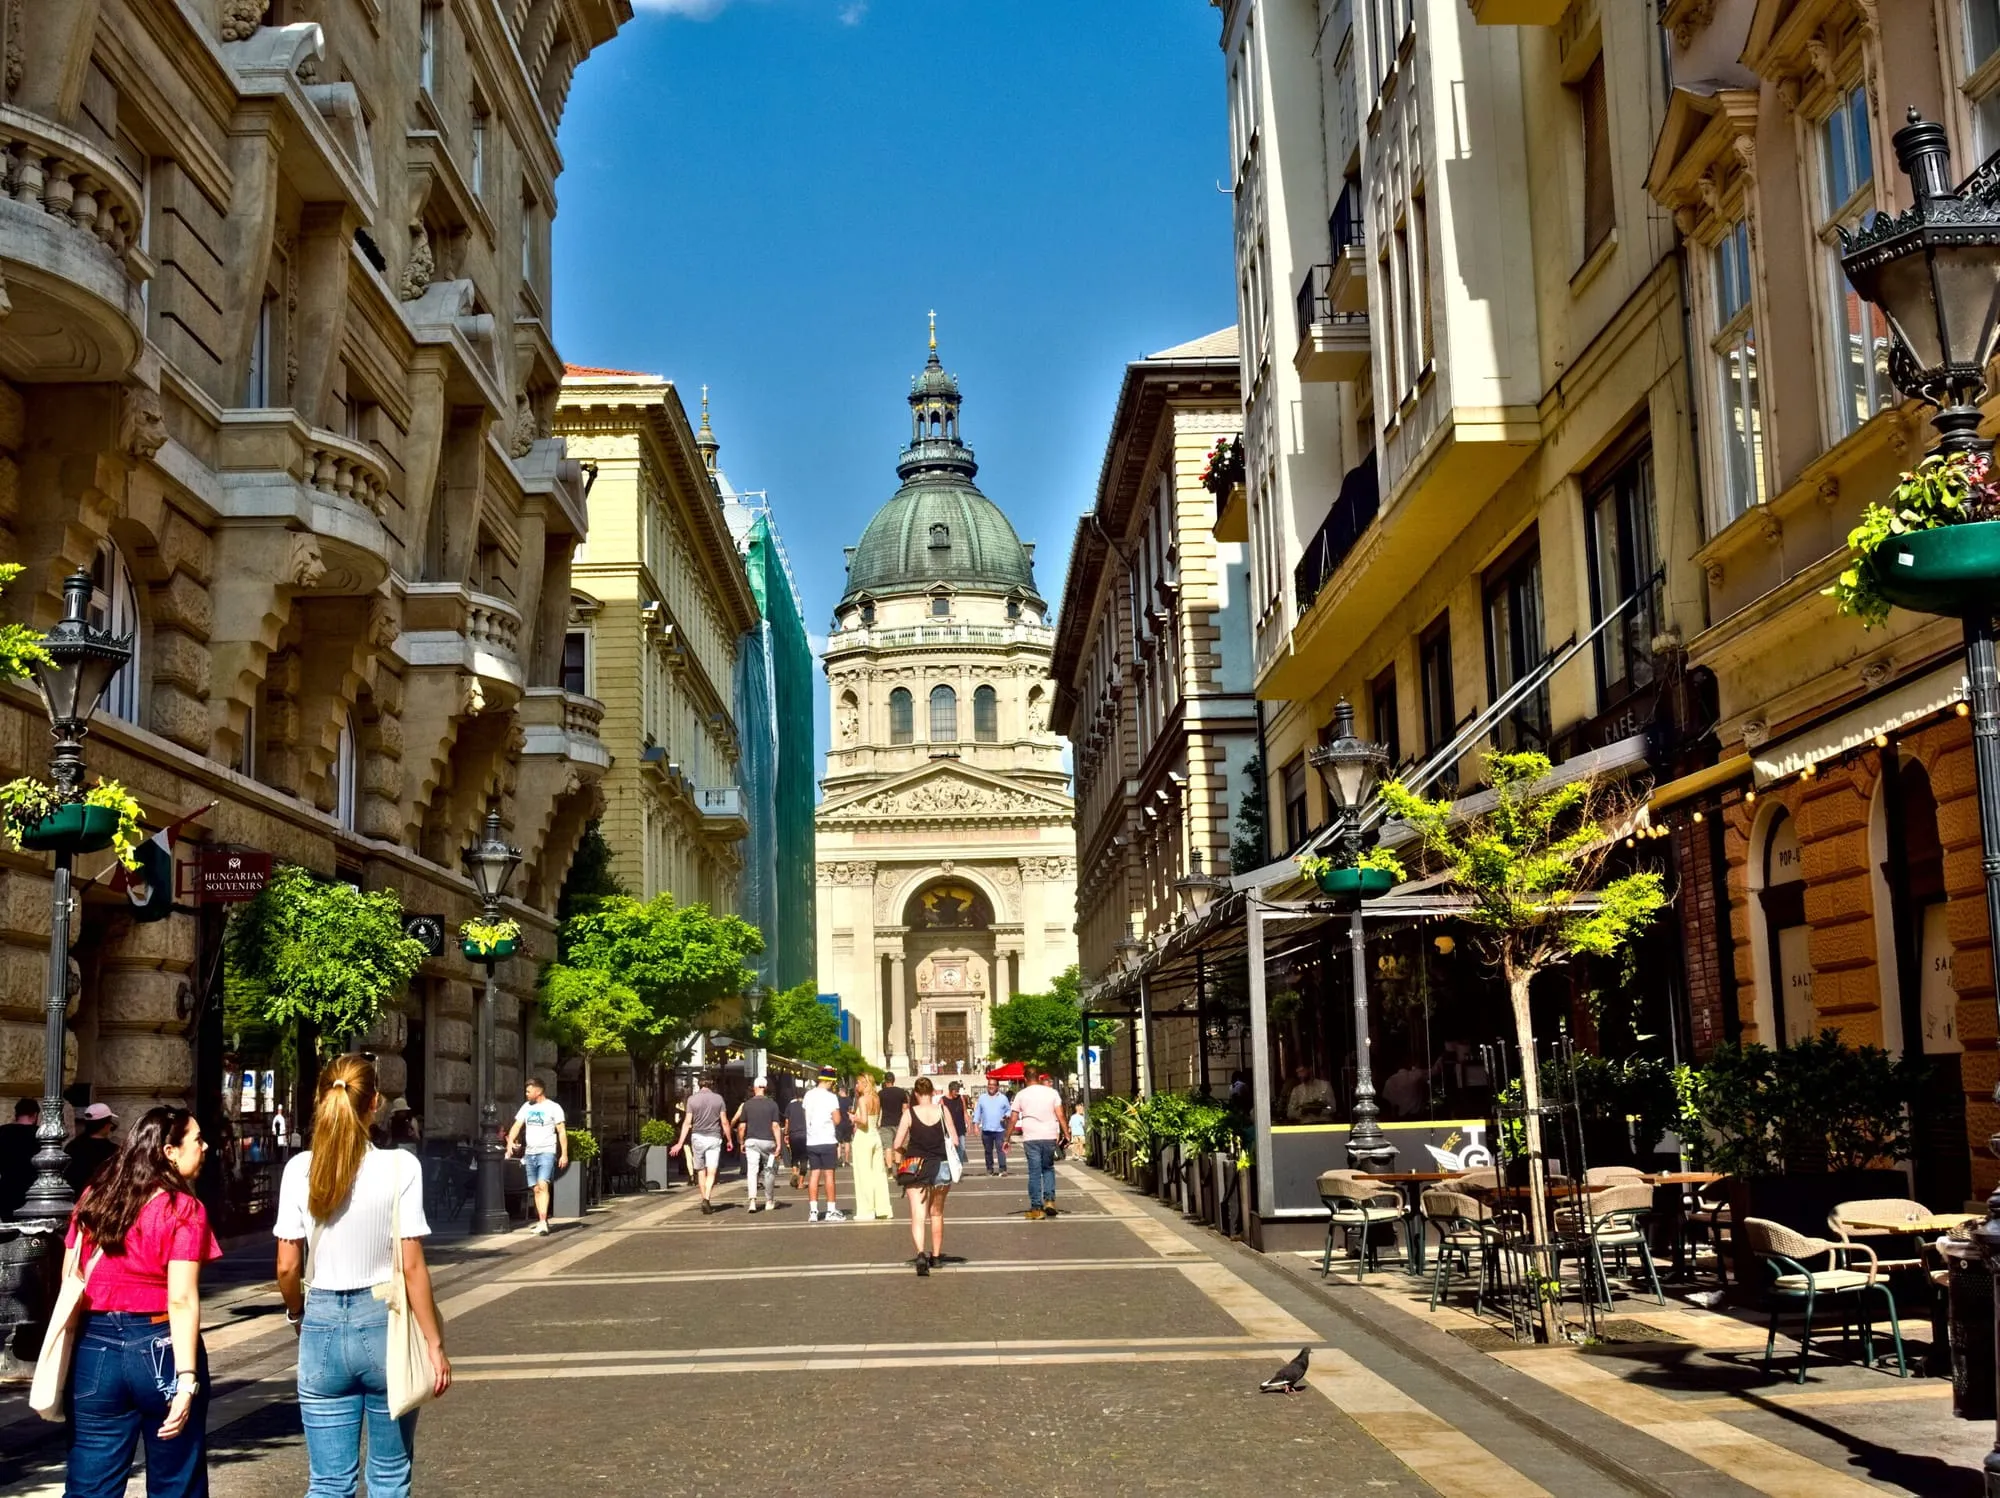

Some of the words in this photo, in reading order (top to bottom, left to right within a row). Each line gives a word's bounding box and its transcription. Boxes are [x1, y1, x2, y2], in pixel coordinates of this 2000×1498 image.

[1604, 707, 1634, 744] CAFÉ
[205, 871, 264, 881] HUNGARIAN
[206, 882, 262, 891] SOUVENIRS
